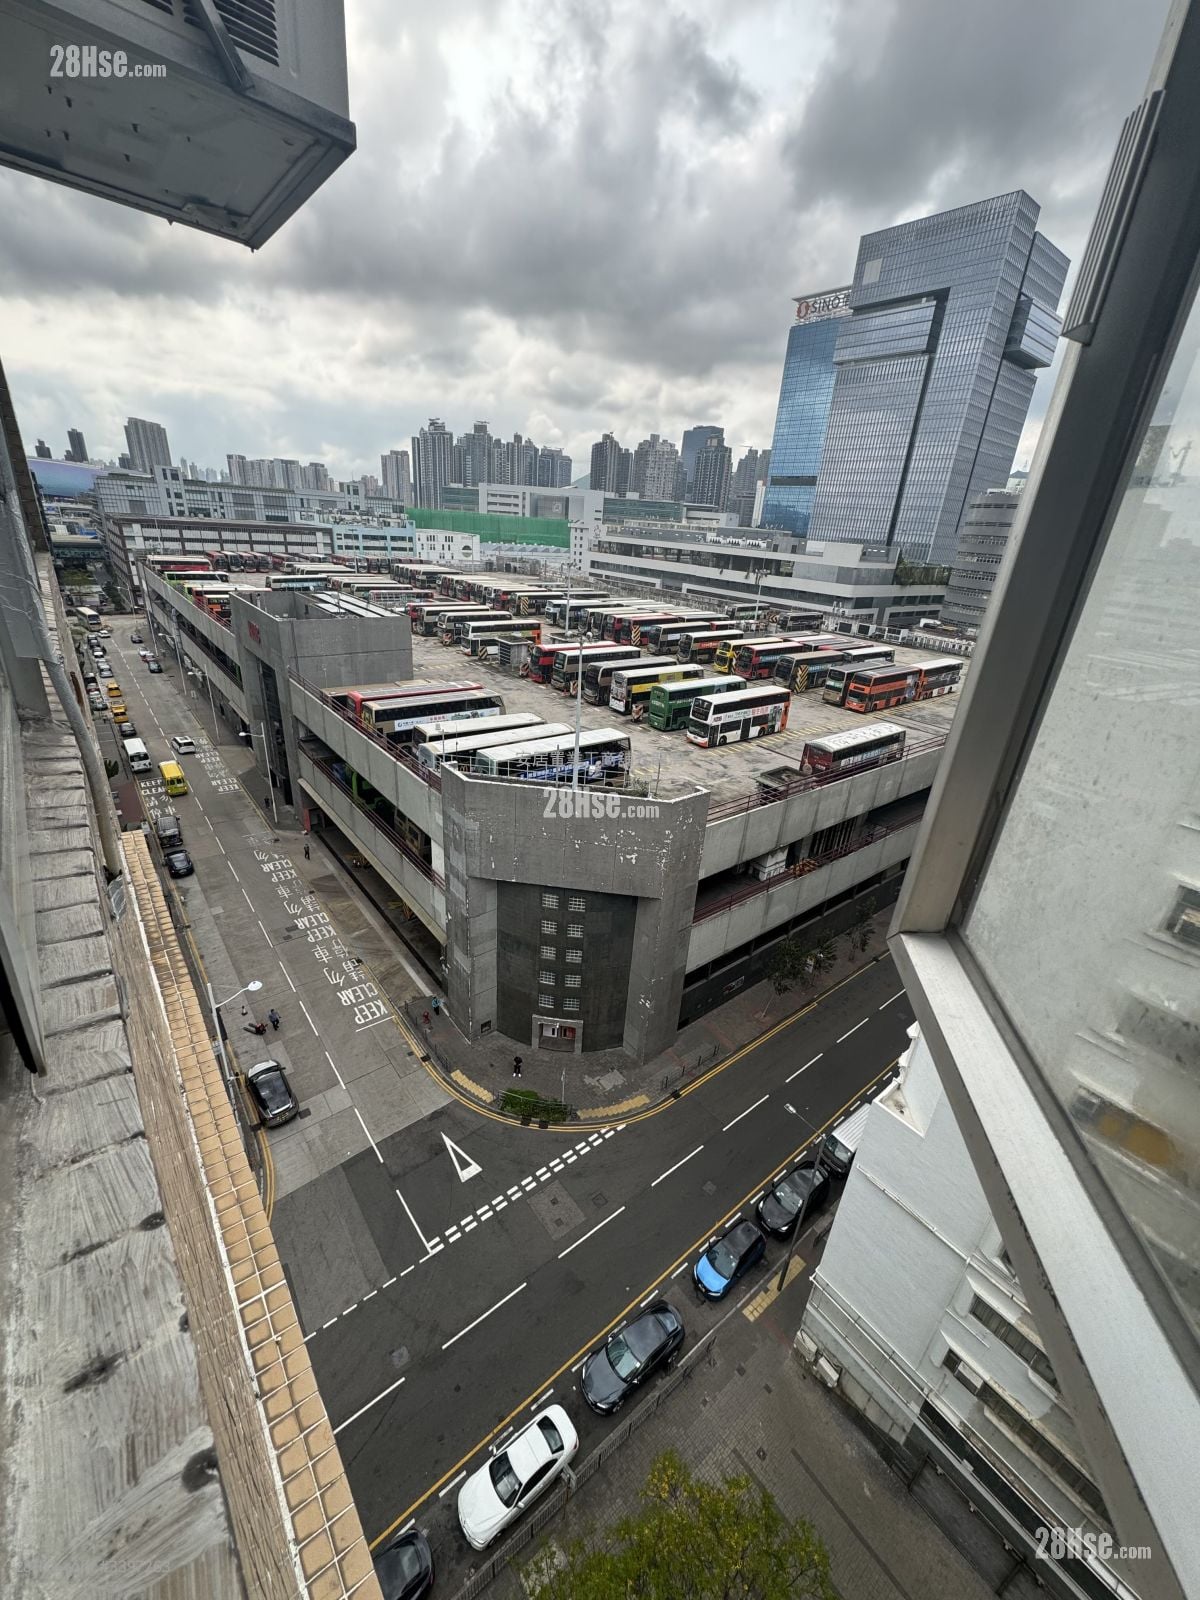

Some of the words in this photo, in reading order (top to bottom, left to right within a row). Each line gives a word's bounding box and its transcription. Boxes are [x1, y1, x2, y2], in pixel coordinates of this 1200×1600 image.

[811, 296, 840, 314] SINO
[140, 779, 163, 788] KEEP
[218, 784, 241, 792] KEEP
[260, 857, 293, 873] CLEAR
[271, 868, 298, 883] KEEP
[293, 911, 330, 931] CLEAR
[307, 924, 337, 944] KEEP
[323, 957, 366, 987] 請勿
[337, 982, 380, 1007] CLEAR
[354, 998, 389, 1025] KEEP
